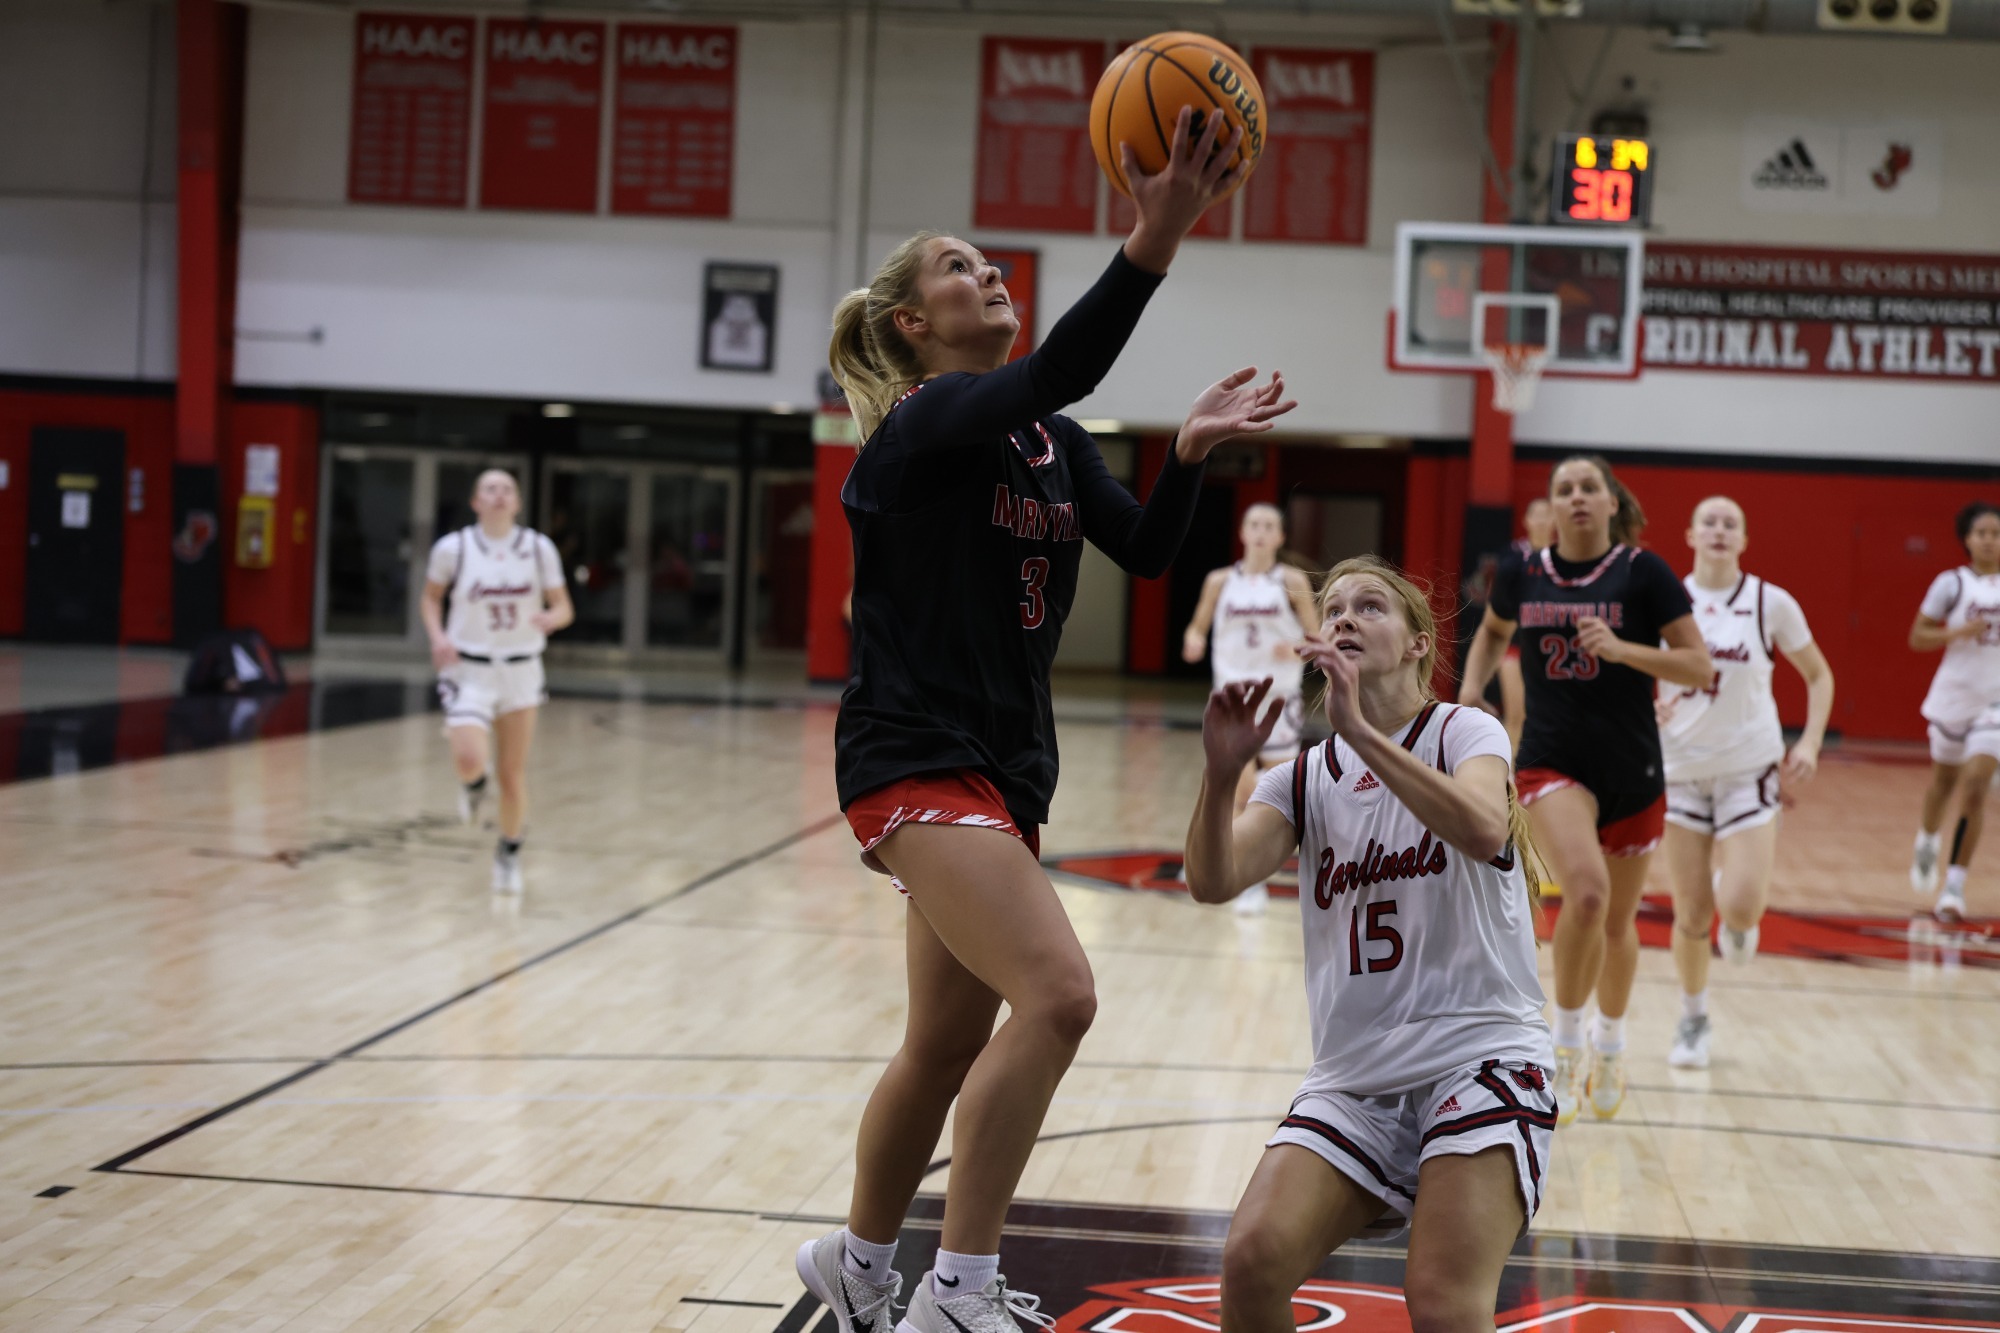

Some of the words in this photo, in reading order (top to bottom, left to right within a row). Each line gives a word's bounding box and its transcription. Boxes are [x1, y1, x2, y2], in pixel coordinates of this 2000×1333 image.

[362, 22, 467, 60] HAAC
[492, 30, 597, 66] HAAC
[622, 34, 729, 70] HAAC
[1569, 168, 1633, 222] 30
[1580, 252, 1695, 281] LIBRTY
[1700, 258, 1831, 287] HOSPITAL
[1839, 261, 1947, 292] SPORTS
[1639, 287, 1724, 315] FFICIAL
[1726, 290, 1875, 320] HEALTHCARE
[1878, 298, 1993, 325] PROVIDER
[1586, 312, 1810, 371] CRDINAL
[1019, 556, 1050, 630] 3
[488, 603, 518, 630] 33
[1541, 634, 1601, 681] 23
[1353, 780, 1380, 792] adidas
[1314, 829, 1448, 910] Cardinals
[1349, 899, 1404, 976] 15
[1435, 1105, 1462, 1117] adidas
